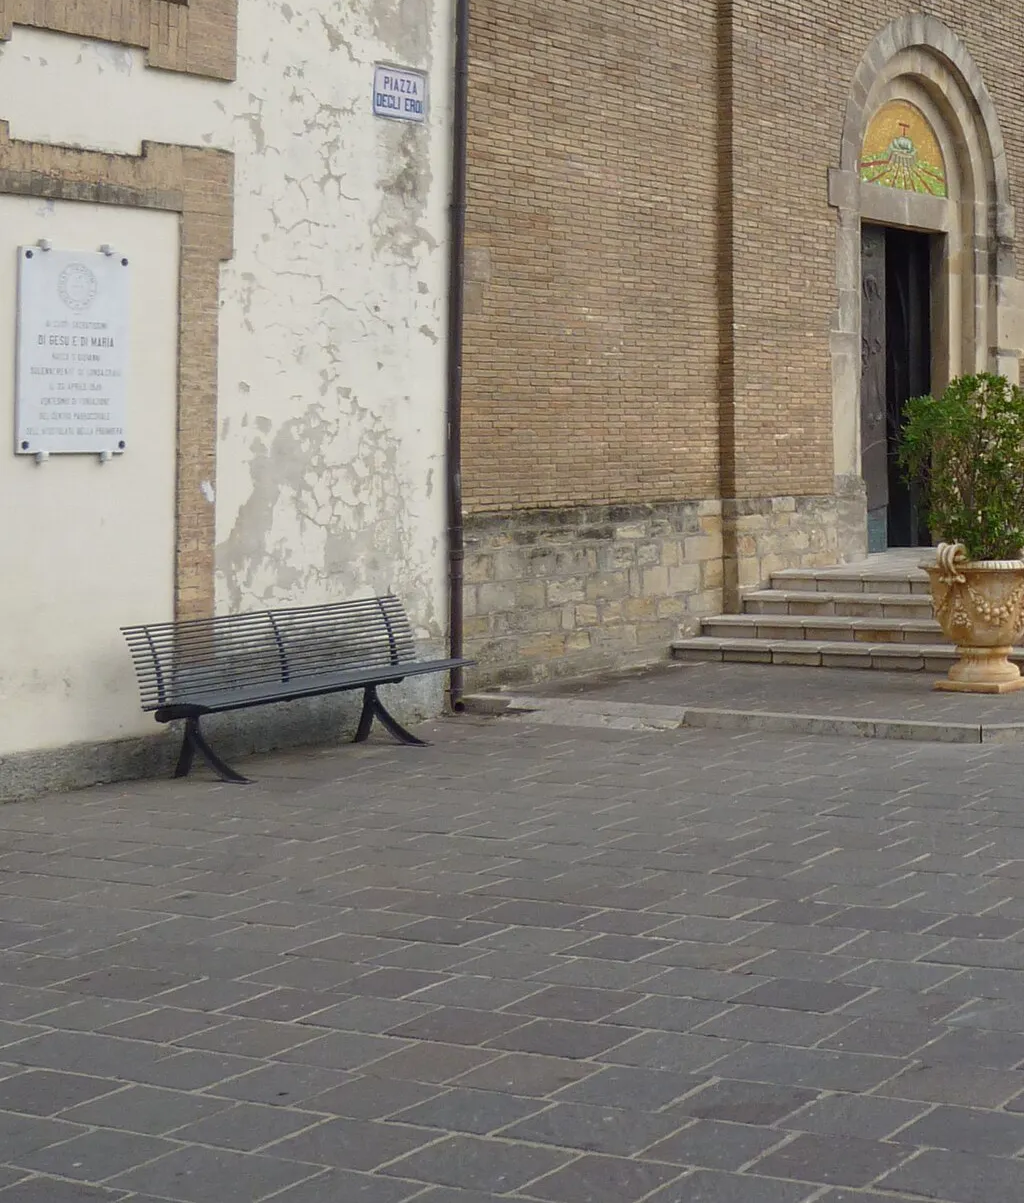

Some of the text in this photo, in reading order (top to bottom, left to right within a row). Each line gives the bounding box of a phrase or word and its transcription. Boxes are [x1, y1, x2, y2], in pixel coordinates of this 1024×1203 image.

[384, 76, 418, 95] PIAZZA
[376, 92, 423, 114] DEGLI EROI
[38, 334, 46, 346] DI
[72, 336, 78, 347] E
[80, 336, 88, 347] DI
[90, 336, 115, 348] MARIA
